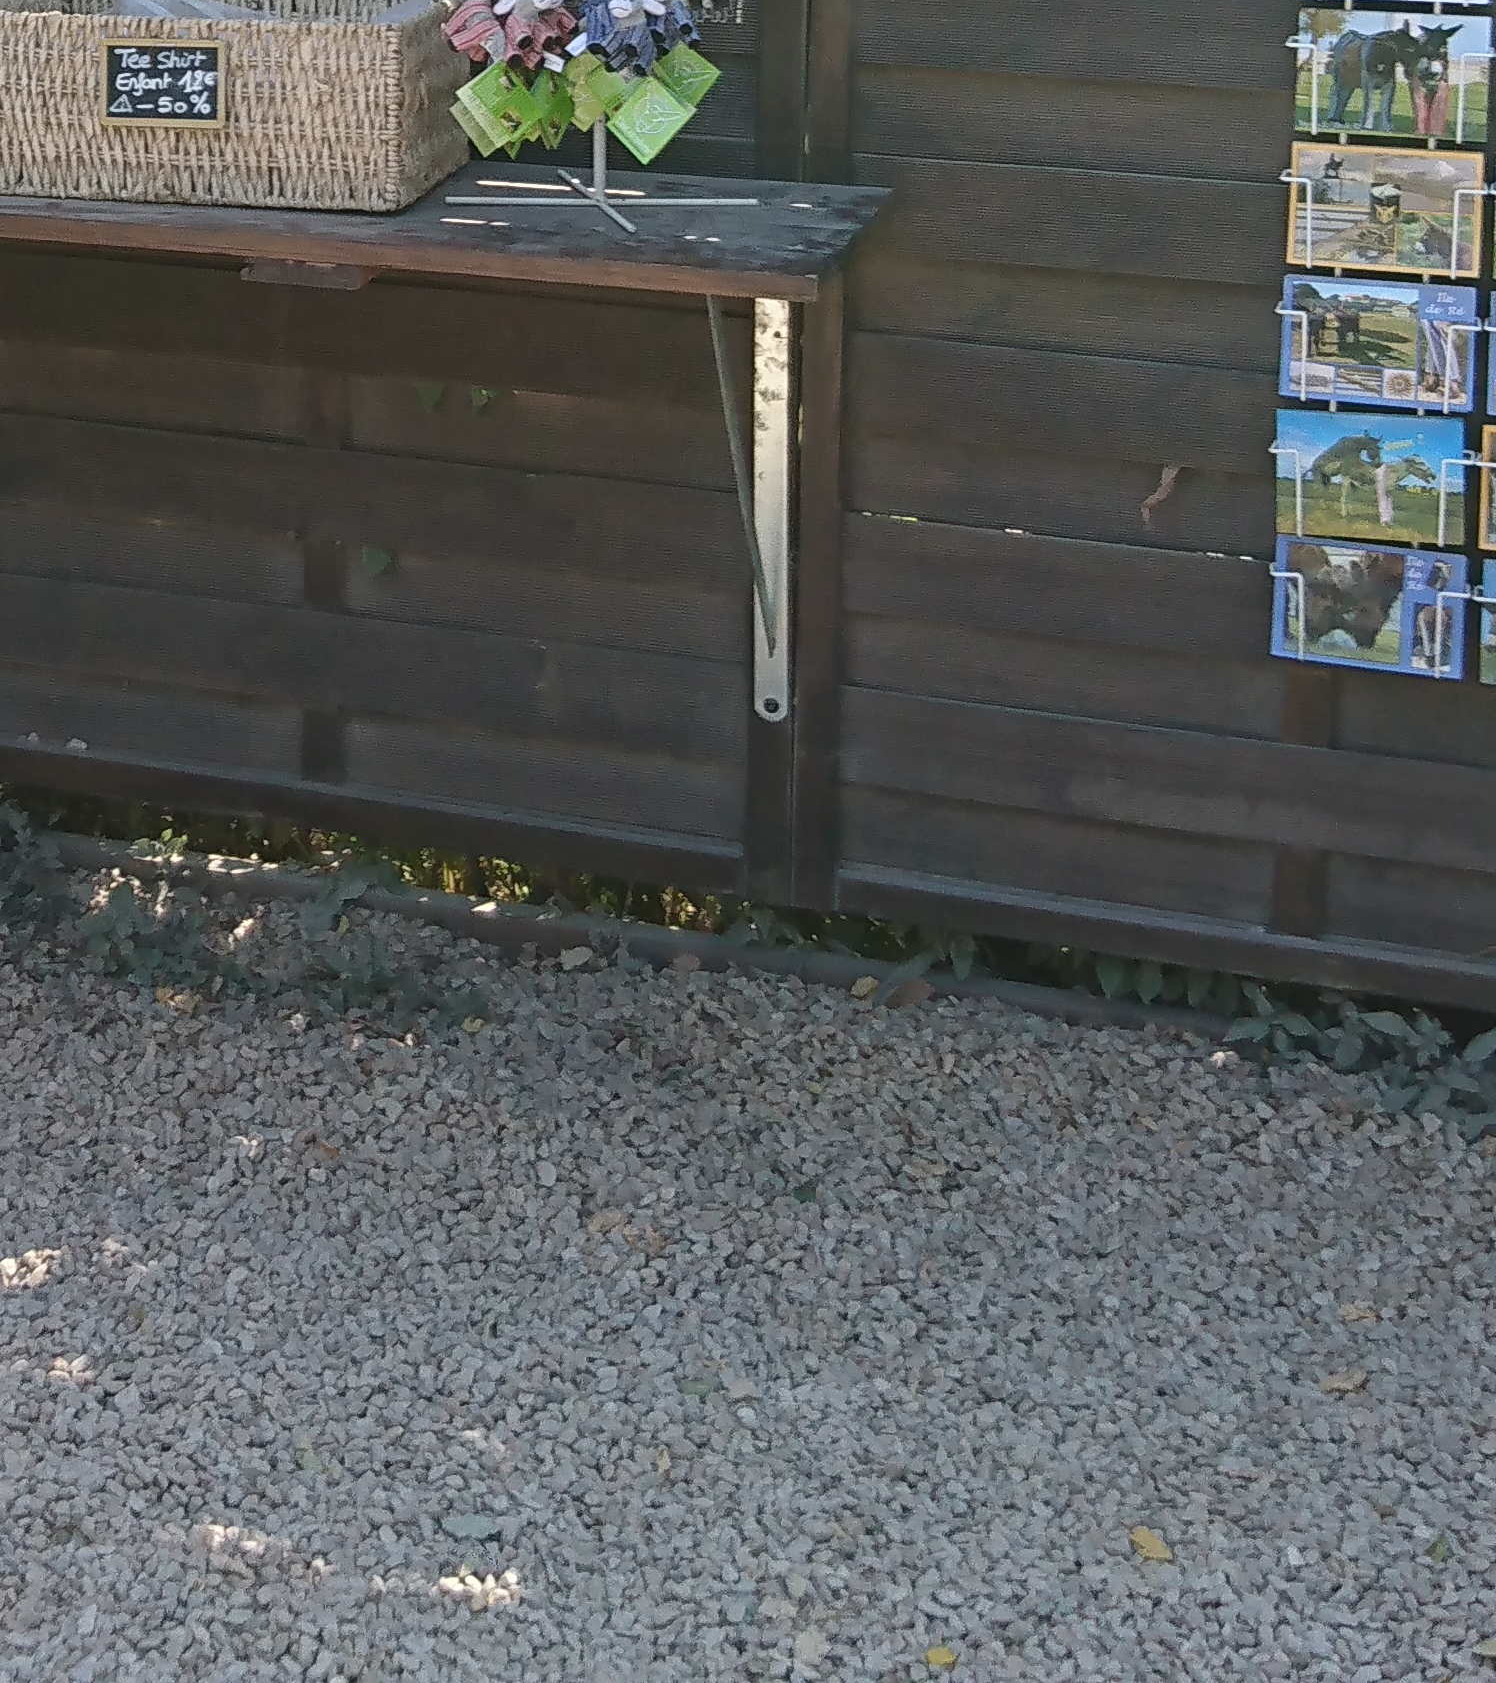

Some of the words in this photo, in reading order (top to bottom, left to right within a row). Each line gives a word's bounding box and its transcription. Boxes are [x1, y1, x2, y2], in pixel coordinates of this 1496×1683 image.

[113, 47, 153, 70] Tee
[156, 49, 207, 70] Shirt
[115, 71, 173, 96] Enfant
